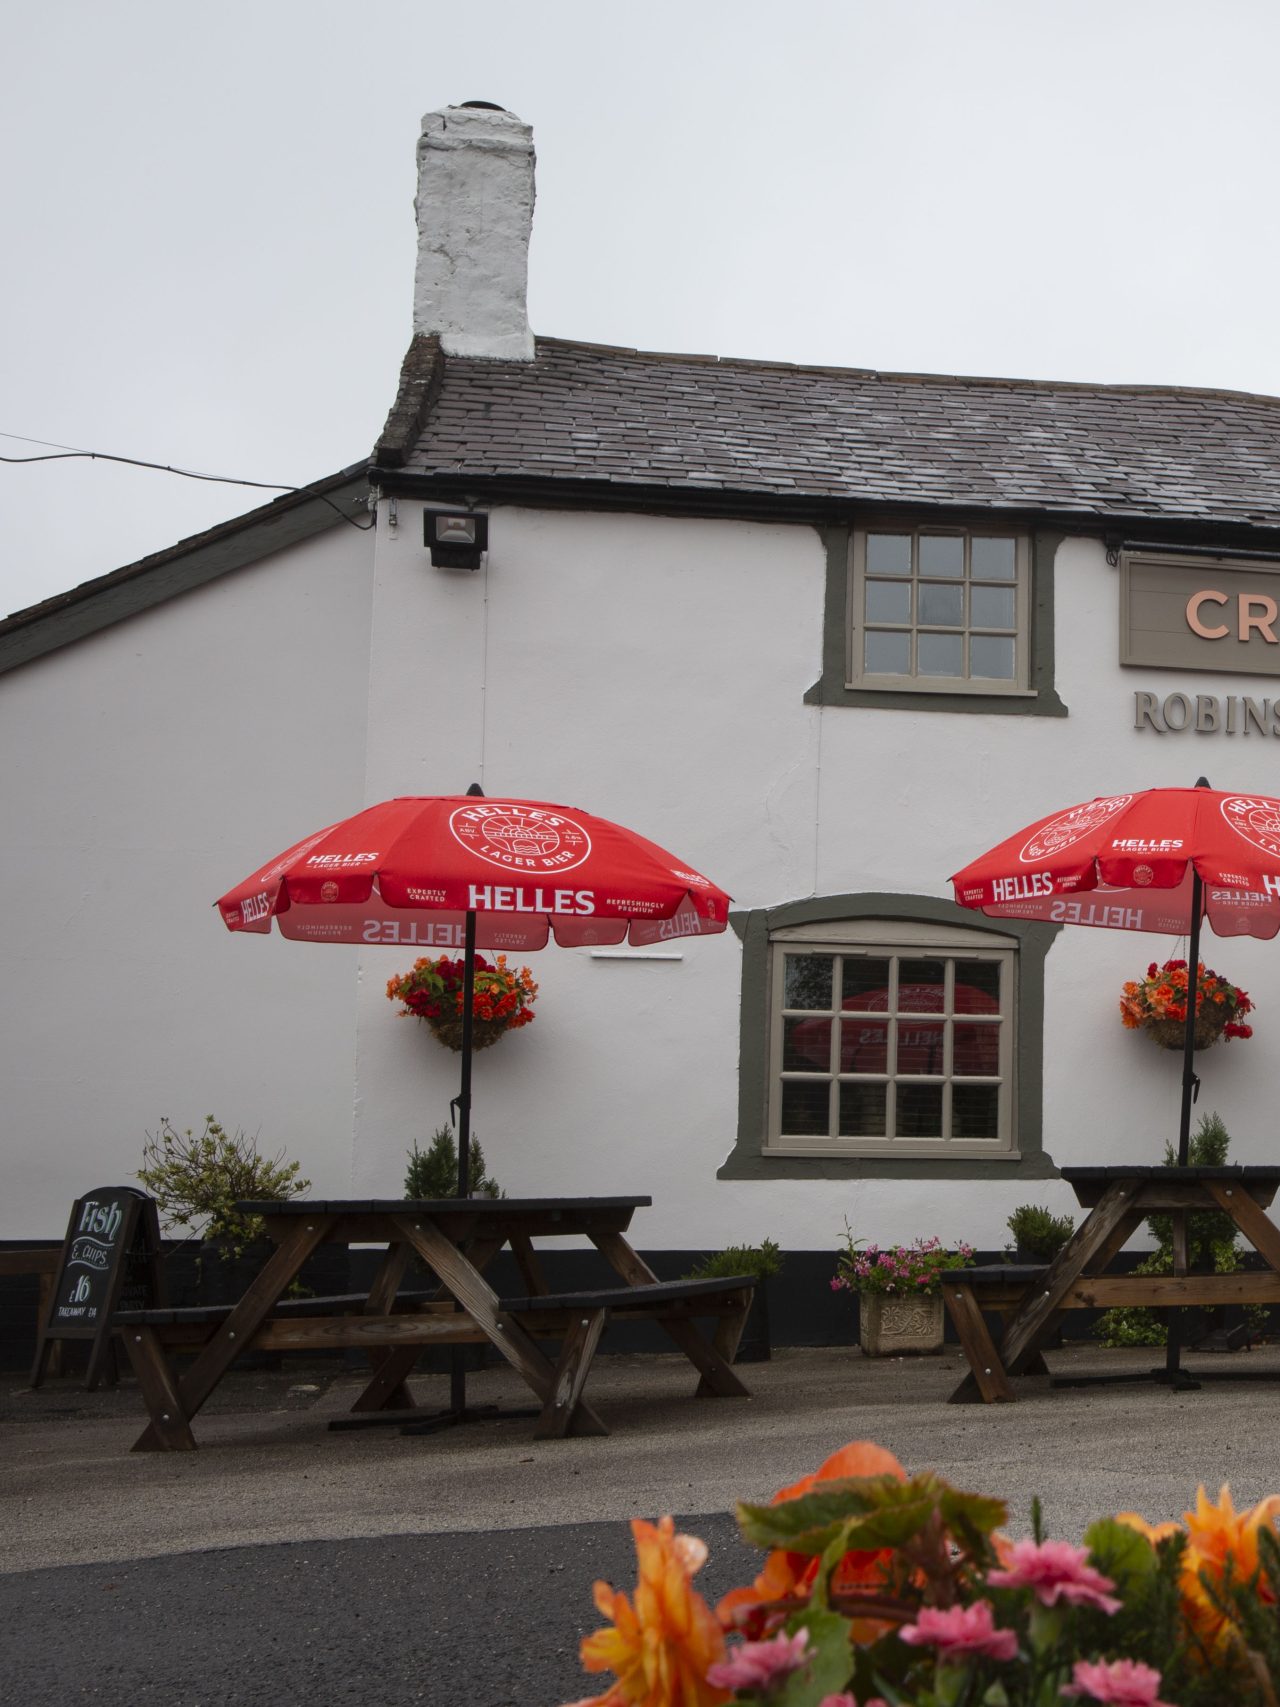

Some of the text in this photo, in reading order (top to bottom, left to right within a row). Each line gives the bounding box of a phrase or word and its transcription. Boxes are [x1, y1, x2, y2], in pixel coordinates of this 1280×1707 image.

[462, 808, 564, 826] HELLES
[1112, 840, 1183, 848] HELLES
[307, 853, 379, 864] HELLES
[481, 846, 575, 866] LAGER BIER
[1219, 872, 1249, 881] EXPERTLY
[1223, 878, 1250, 886] CRAFTED
[407, 888, 446, 896] EXPERTLY
[992, 872, 1053, 901] HELLES
[409, 894, 446, 902] CRAFTED
[468, 885, 595, 915] HELLES
[606, 899, 664, 909] REFRESHINGLY
[241, 892, 269, 923] HELLES
[618, 905, 653, 914] PREMIUM
[79, 1201, 122, 1240] Fish
[72, 1245, 78, 1259] &
[82, 1245, 107, 1265] CHIPS
[69, 1275, 91, 1302] £16
